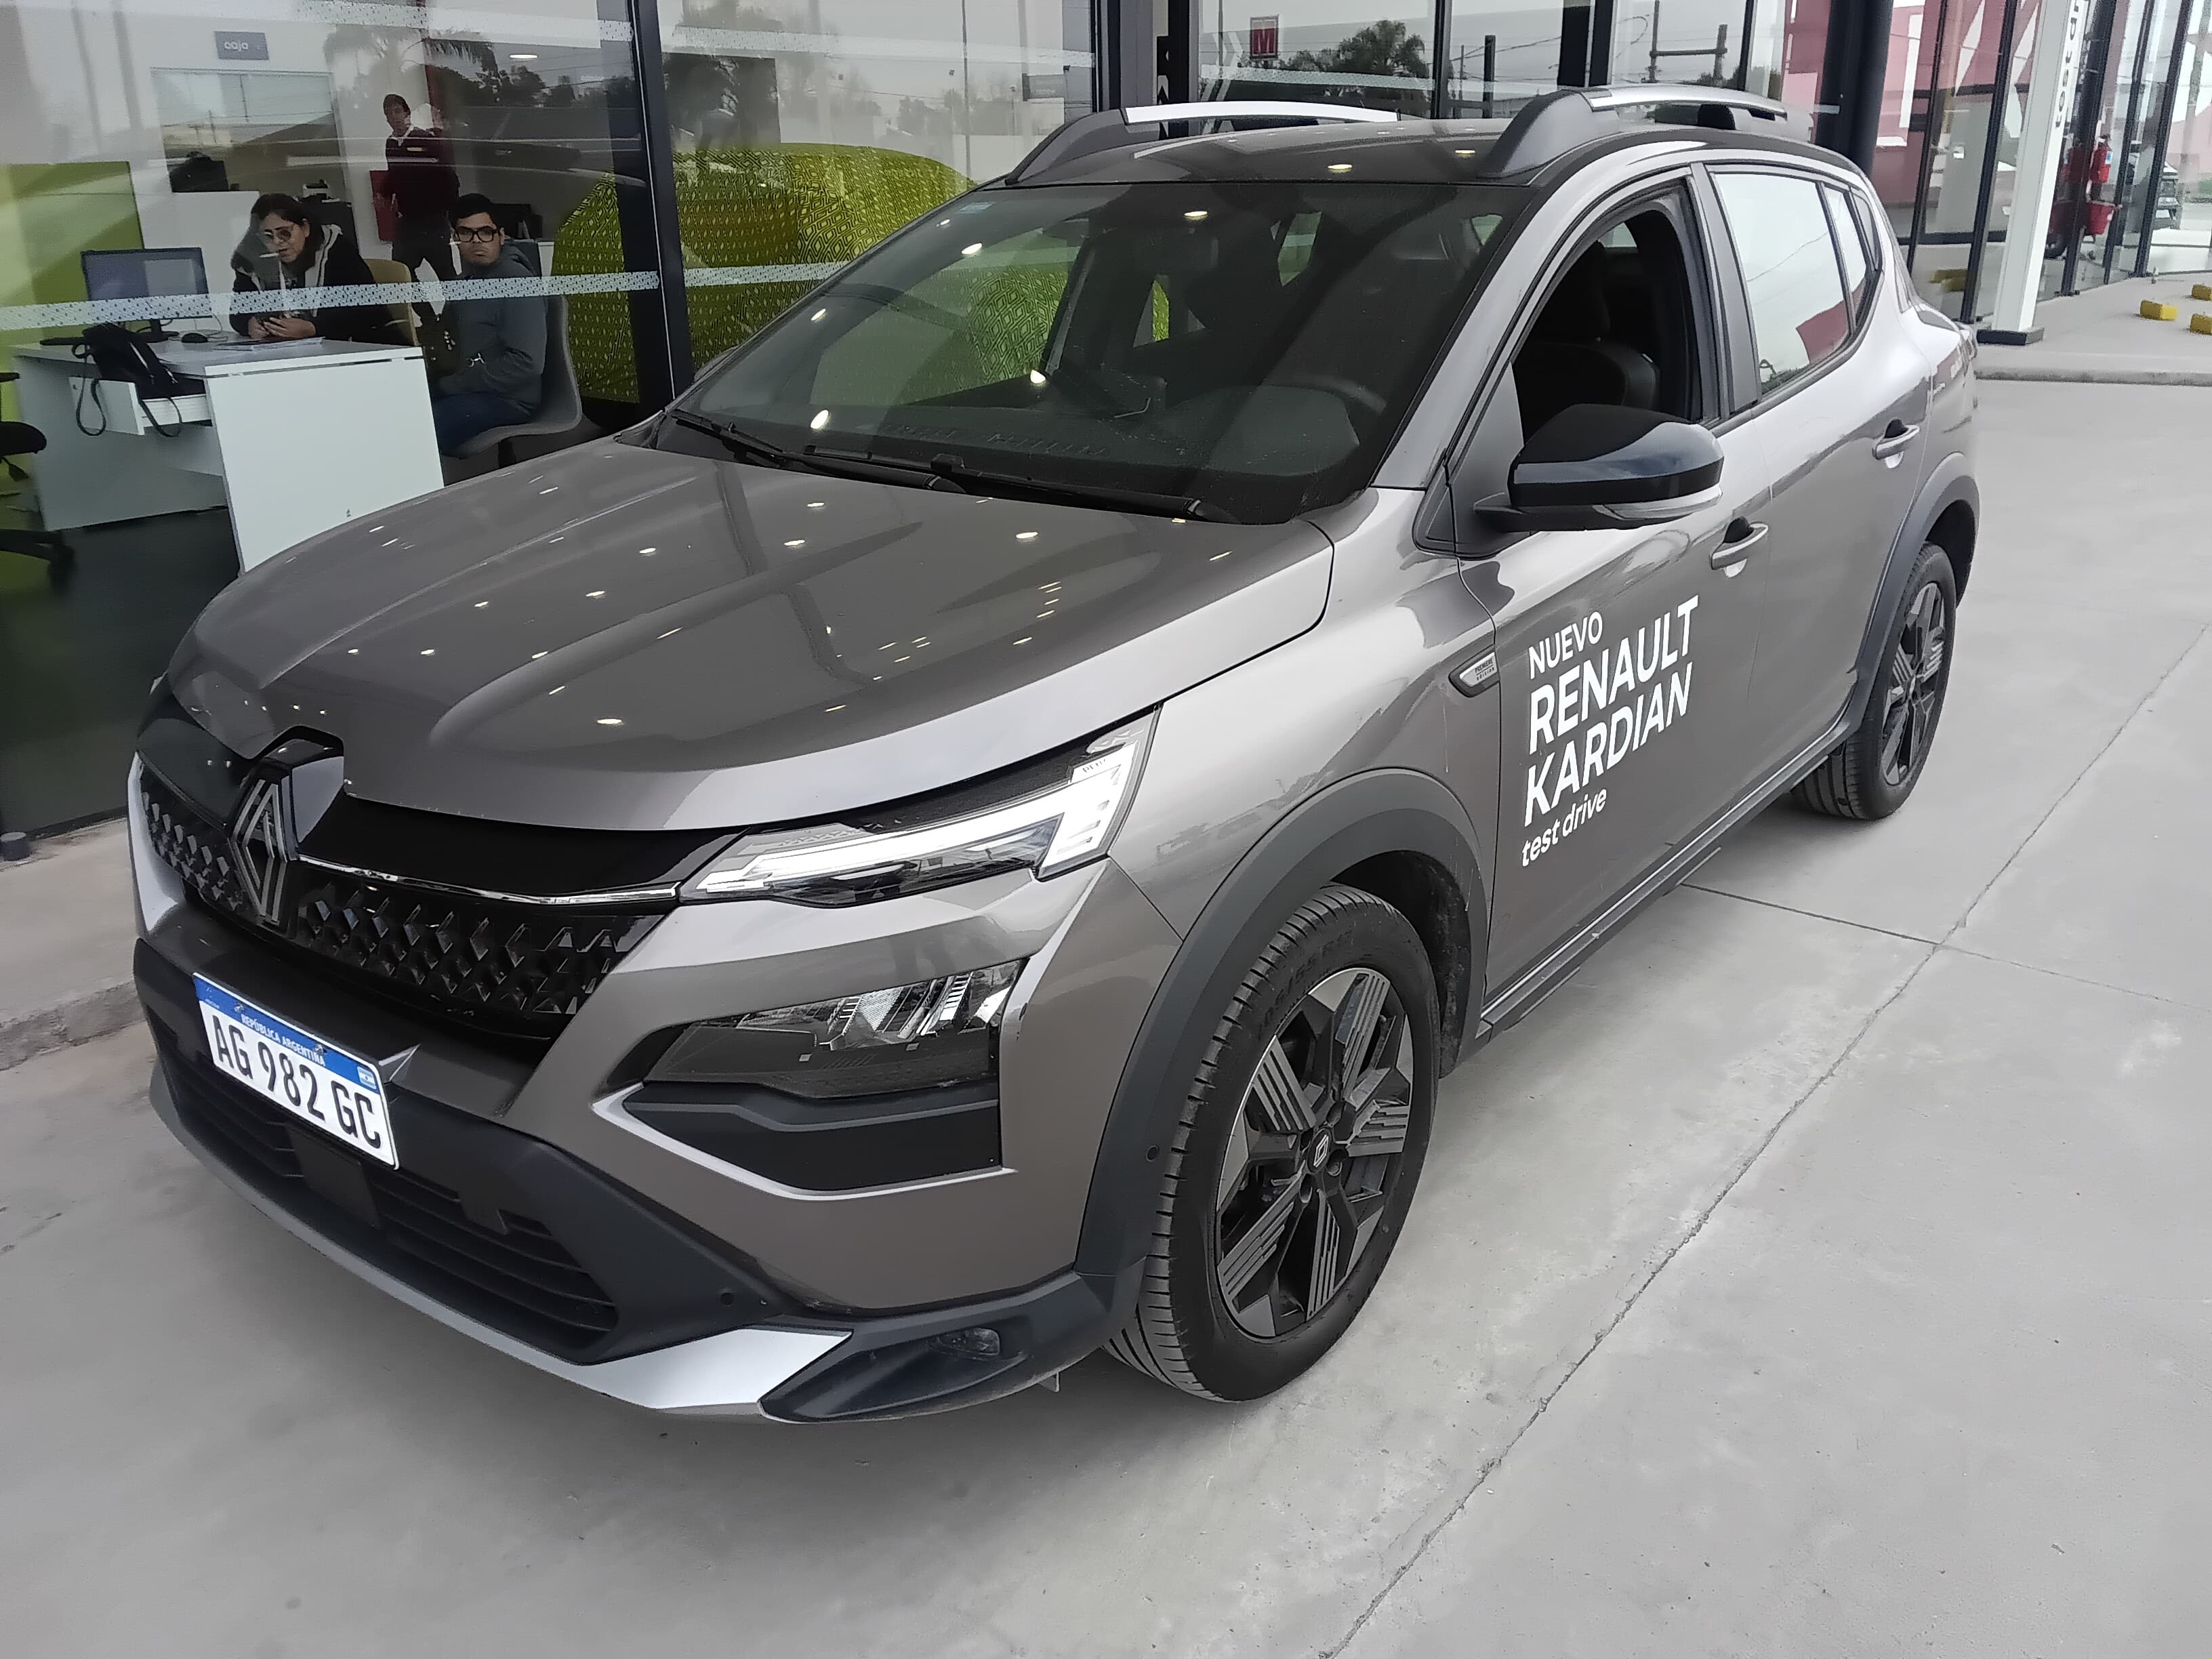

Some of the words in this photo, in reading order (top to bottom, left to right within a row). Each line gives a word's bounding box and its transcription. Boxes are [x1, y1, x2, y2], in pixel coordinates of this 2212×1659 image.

[1528, 611, 1603, 680] NUEVO
[1529, 594, 1699, 755] RENAULT
[1523, 661, 1693, 828] KARDIAN
[1521, 818, 1561, 867] test
[1562, 787, 1607, 838] drive
[211, 1015, 253, 1080] AG
[258, 1041, 325, 1121] 982
[330, 1080, 382, 1149] GC
[241, 1013, 281, 1043] REPÚBLICA
[281, 1035, 326, 1067] ARGENTINA
